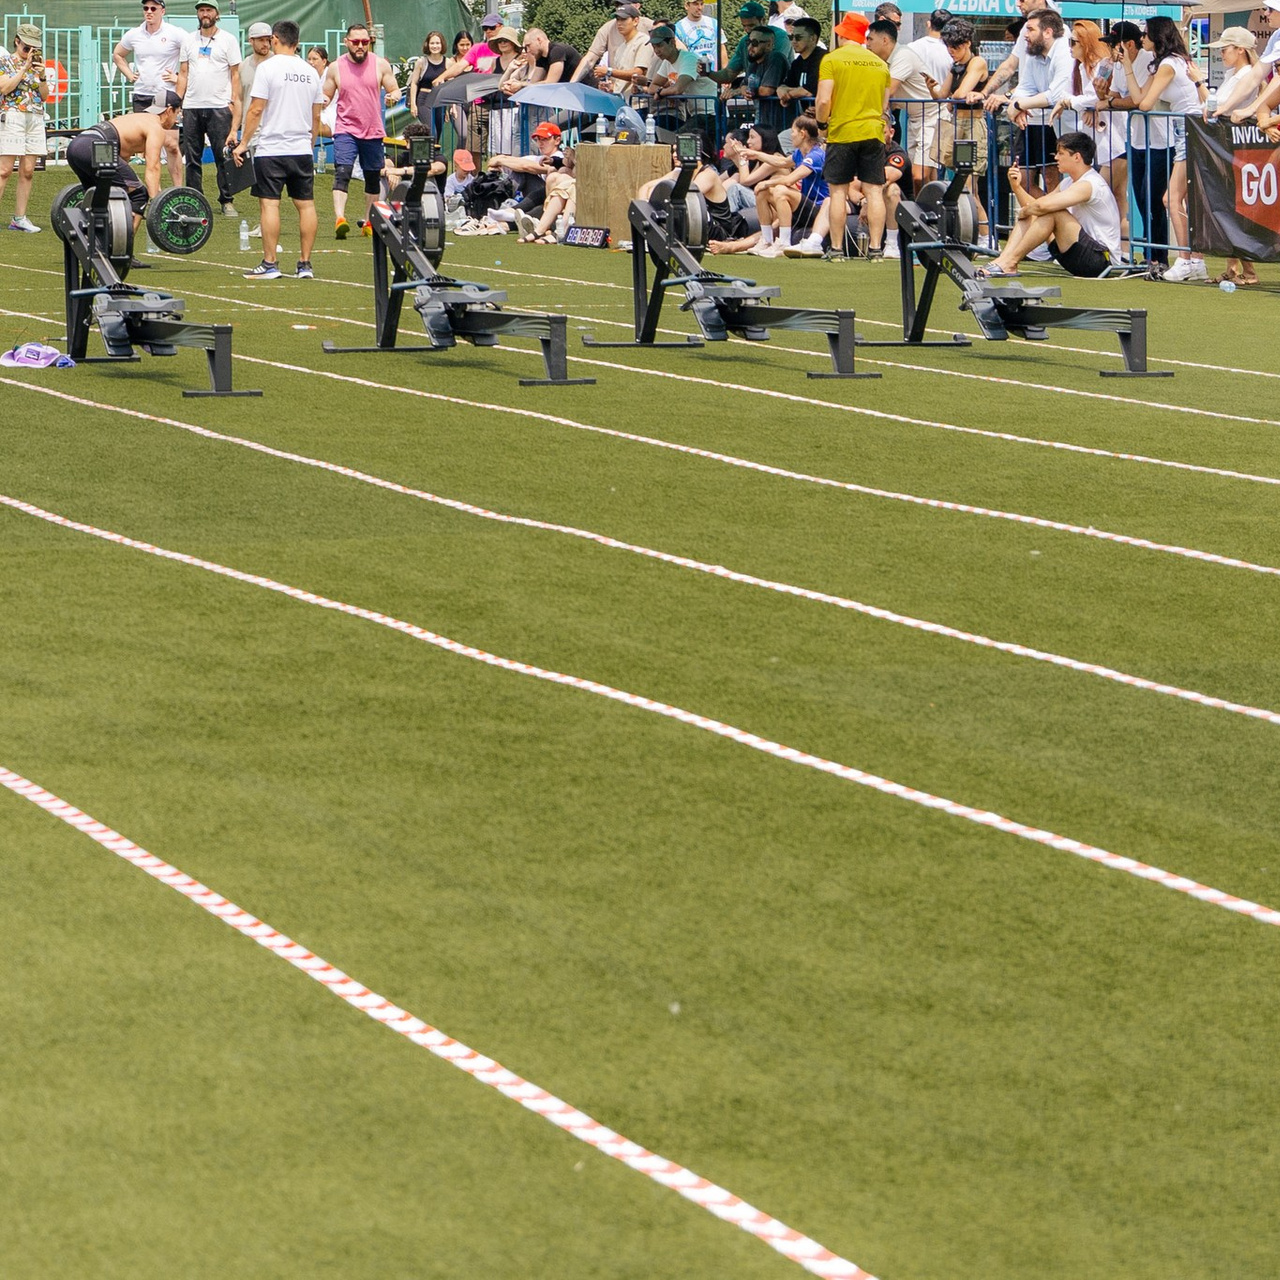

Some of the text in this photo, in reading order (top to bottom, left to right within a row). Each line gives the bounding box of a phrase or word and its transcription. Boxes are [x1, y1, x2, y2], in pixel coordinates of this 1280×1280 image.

[284, 73, 312, 84] JUDGE
[1241, 163, 1278, 205] GO
[161, 196, 200, 219] YOUSTEEL
[167, 225, 204, 246] OUSTEEL
